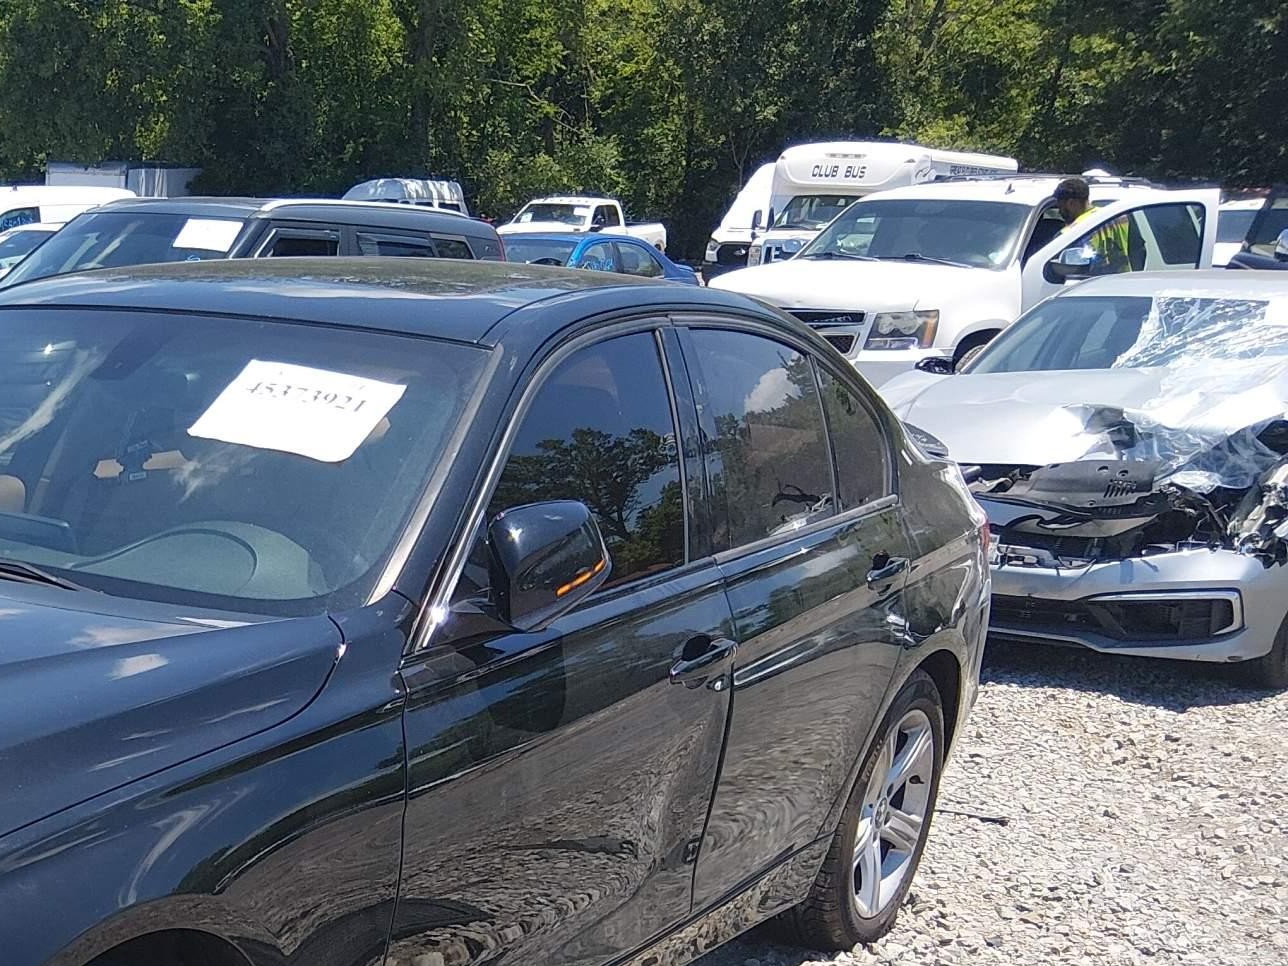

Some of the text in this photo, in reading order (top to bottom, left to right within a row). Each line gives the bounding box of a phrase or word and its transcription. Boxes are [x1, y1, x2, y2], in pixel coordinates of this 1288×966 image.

[811, 164, 867, 179] CLUB BUS
[246, 381, 367, 413] 45373921
